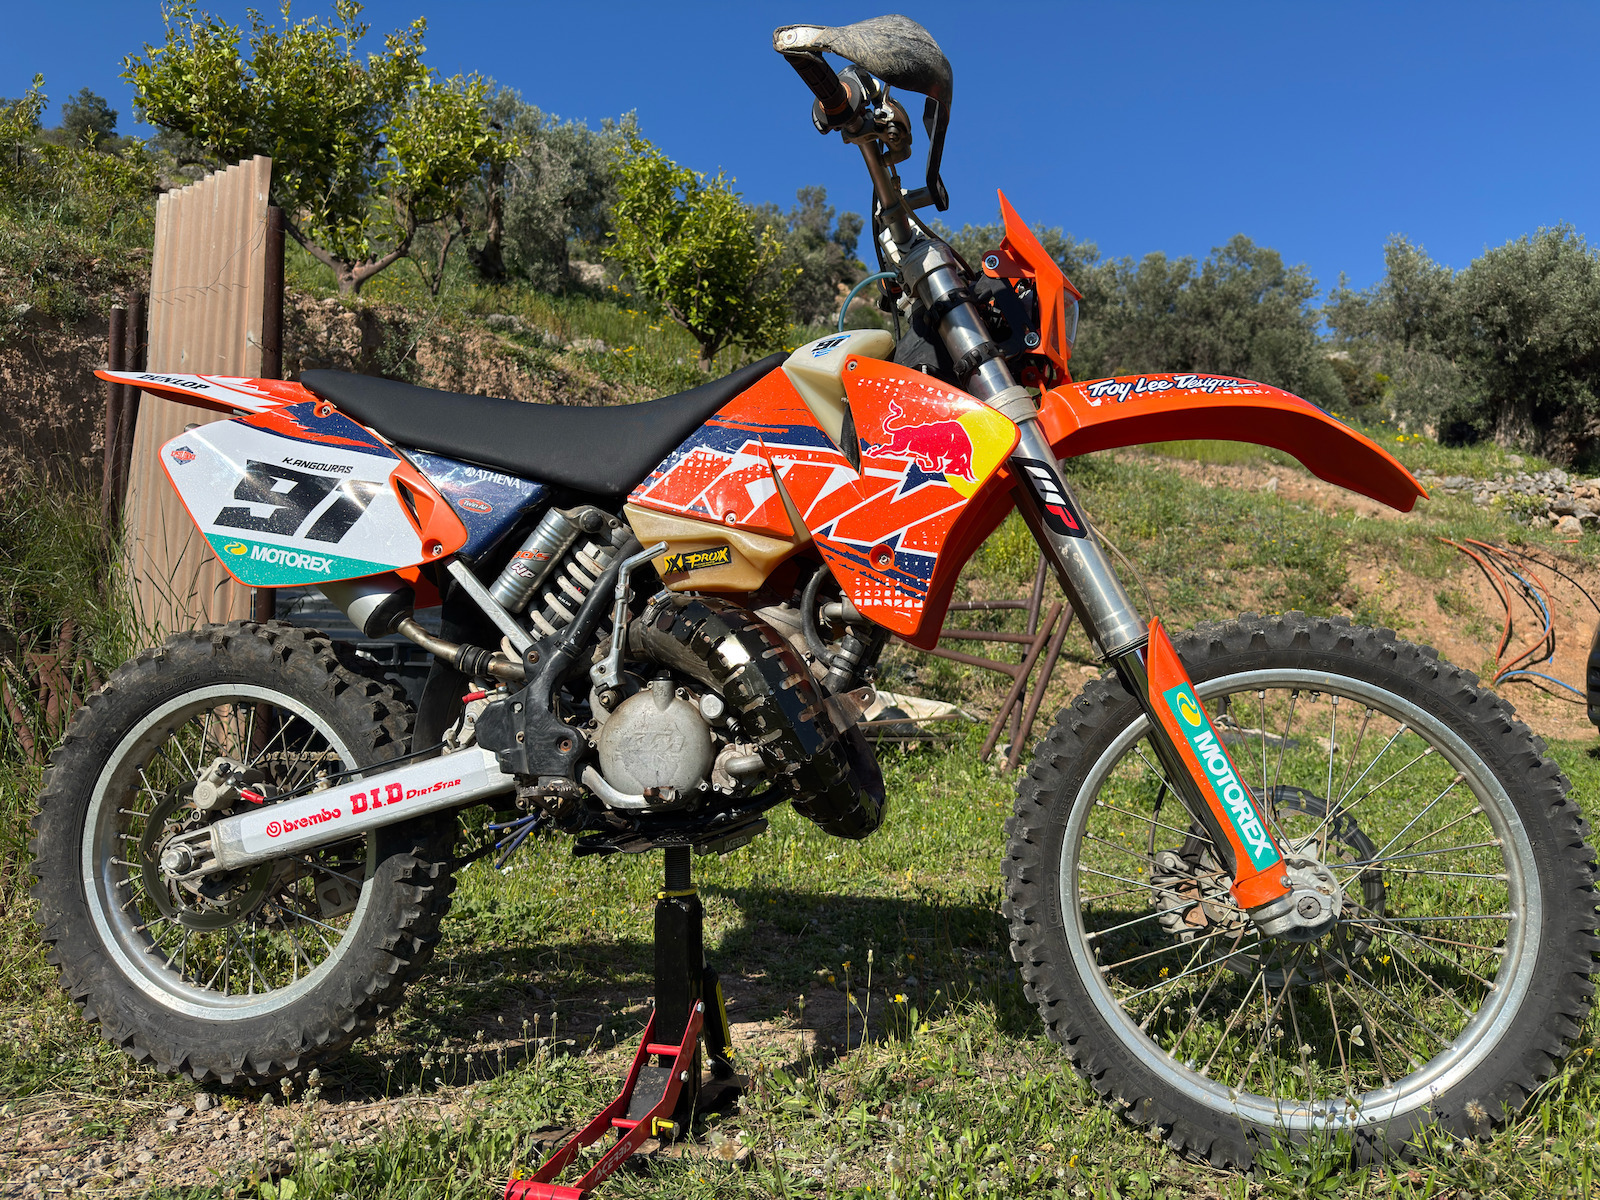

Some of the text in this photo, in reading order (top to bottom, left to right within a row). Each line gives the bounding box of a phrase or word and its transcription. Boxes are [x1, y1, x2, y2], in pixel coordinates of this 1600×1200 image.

[137, 374, 210, 389] DUNLOP
[1087, 379, 1132, 402] Troy
[1134, 377, 1175, 393] Lee
[474, 469, 521, 489] ATHENA
[213, 459, 384, 544] 91
[463, 499, 490, 512] Twin Air
[250, 545, 334, 574] MOTOREX
[283, 808, 342, 833] brembo
[350, 782, 404, 815] D.I.D
[1193, 729, 1274, 860] MOTOREX
